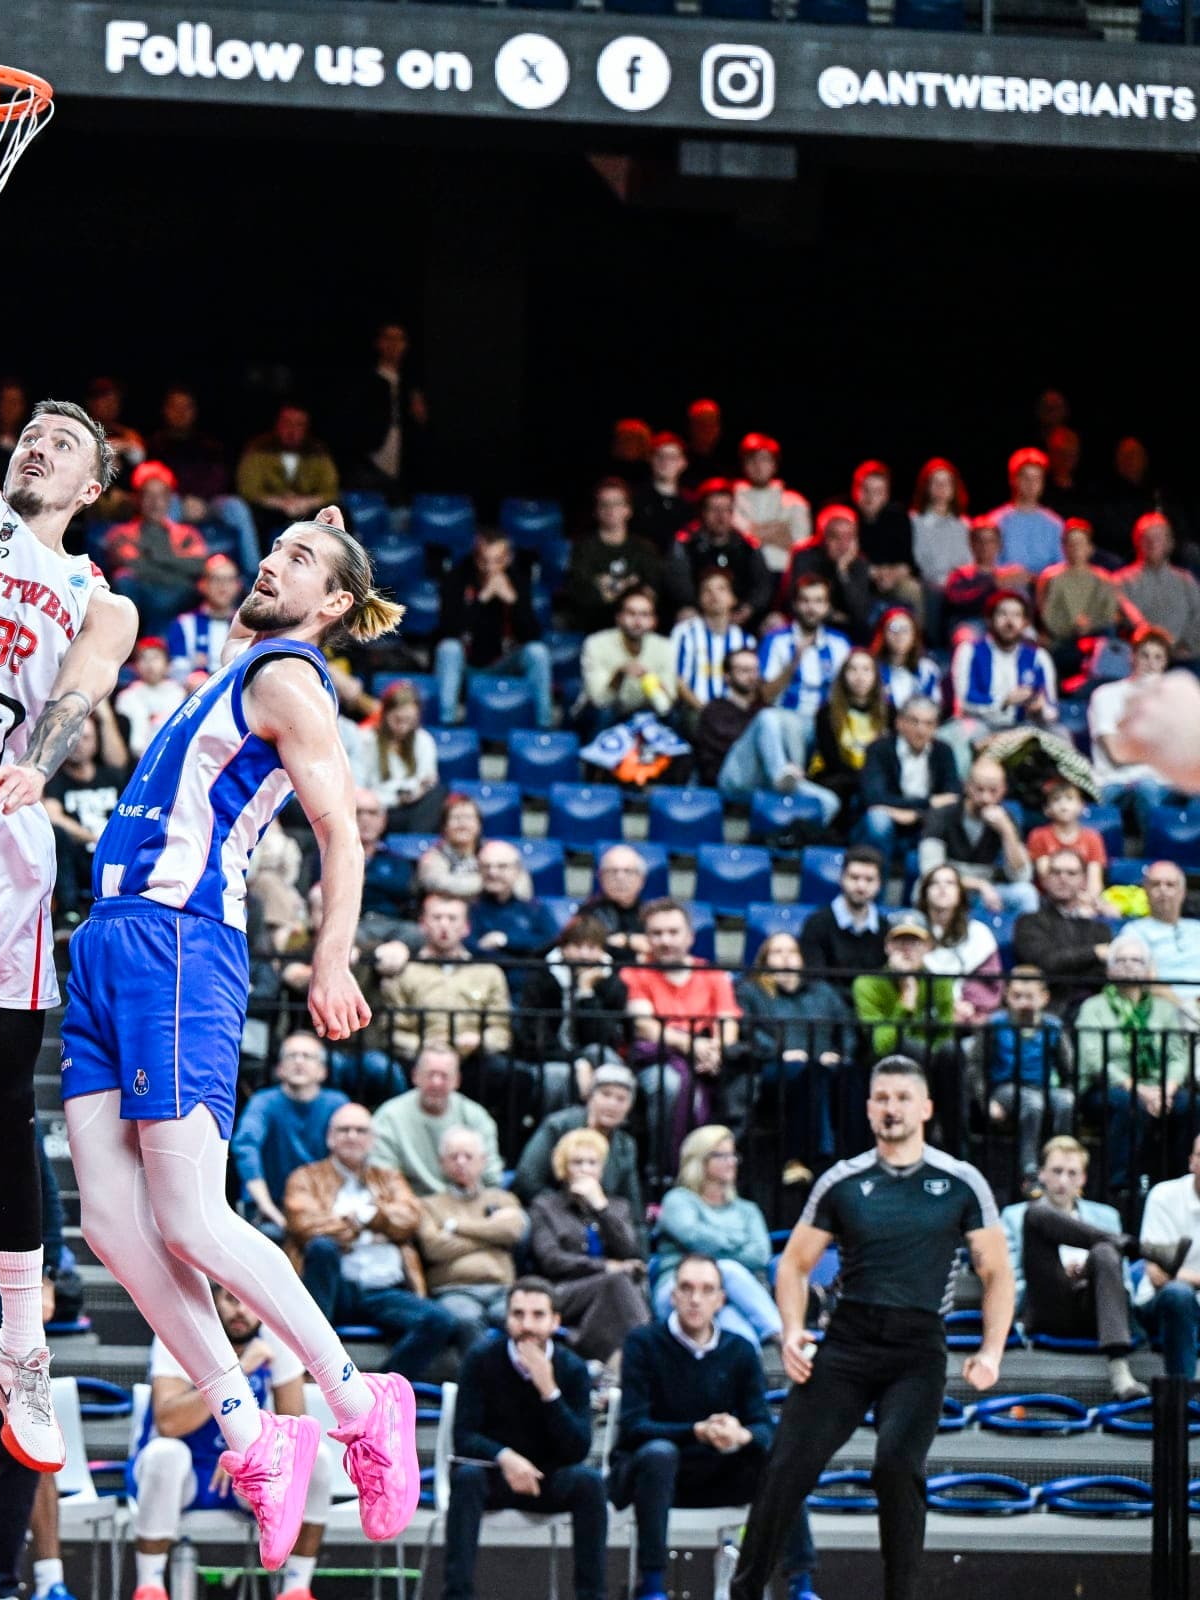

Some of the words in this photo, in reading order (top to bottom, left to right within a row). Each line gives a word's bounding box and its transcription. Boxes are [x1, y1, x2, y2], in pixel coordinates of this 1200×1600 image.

[105, 20, 303, 82] Follow
[315, 44, 384, 87] us
[397, 48, 473, 92] on
[818, 65, 1197, 122] @ANTWERPGIANTS
